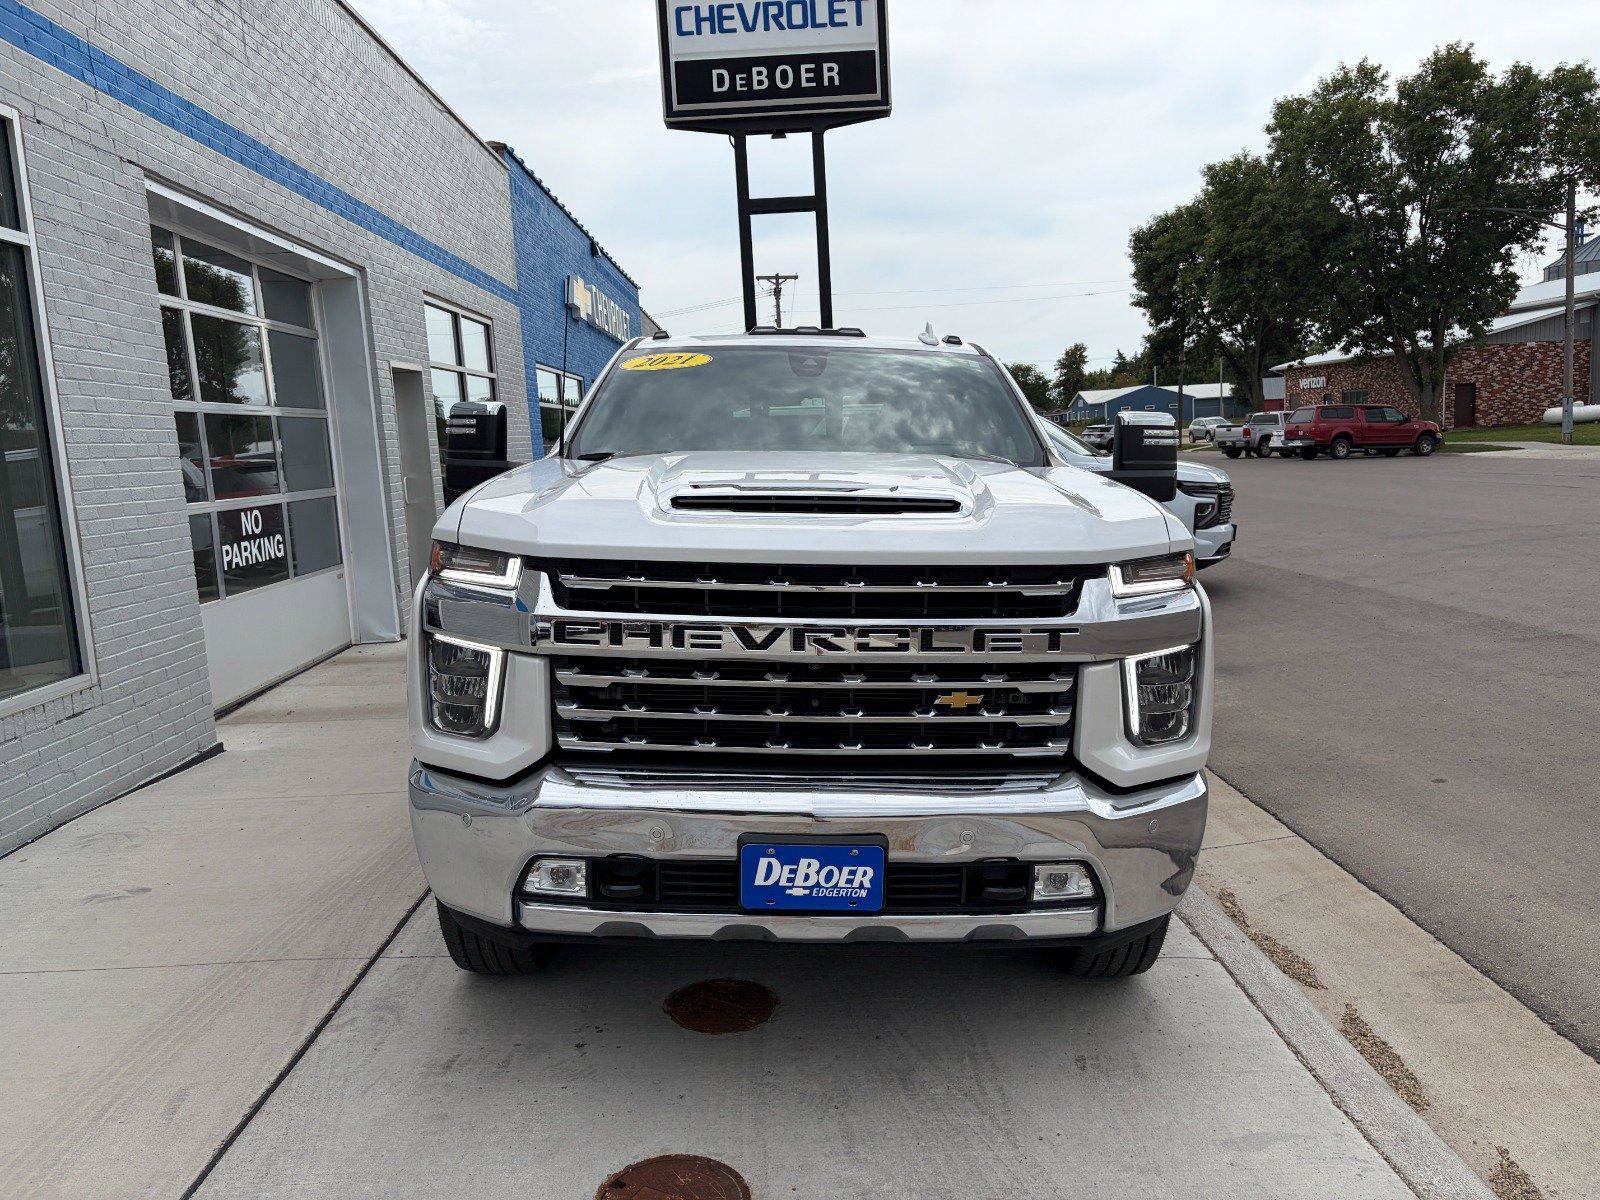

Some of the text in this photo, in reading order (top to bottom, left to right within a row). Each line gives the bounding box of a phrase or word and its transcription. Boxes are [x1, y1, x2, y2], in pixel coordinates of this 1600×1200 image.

[675, 0, 864, 37] CHEVROLET
[633, 354, 699, 367] 2021
[240, 509, 262, 537] NO
[221, 533, 285, 570] PARKING
[552, 619, 1080, 653] CHEVROLET
[812, 887, 868, 898] EDGERTON
